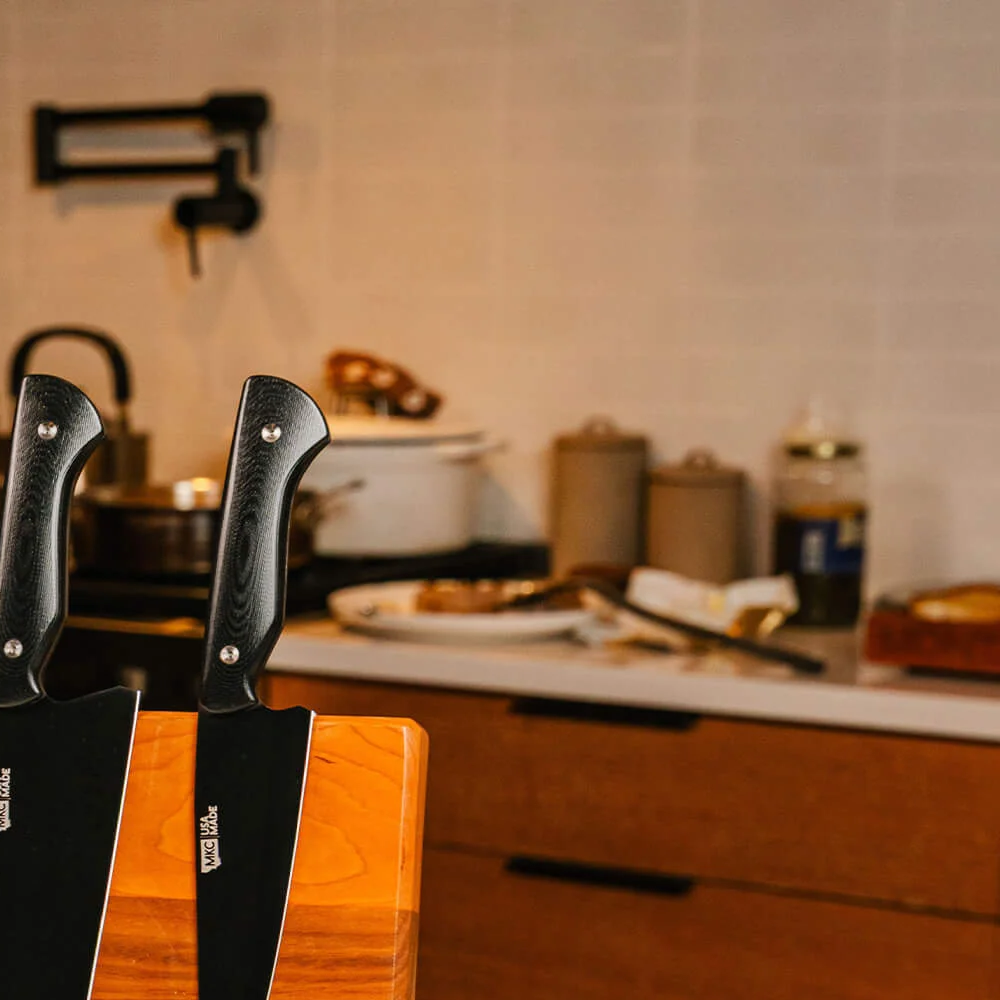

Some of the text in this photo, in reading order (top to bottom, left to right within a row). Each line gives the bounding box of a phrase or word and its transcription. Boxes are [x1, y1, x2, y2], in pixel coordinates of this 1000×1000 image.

[0, 768, 10, 797] MADE
[200, 816, 209, 835] USA
[208, 805, 218, 835] MADE
[204, 841, 215, 866] MKC
